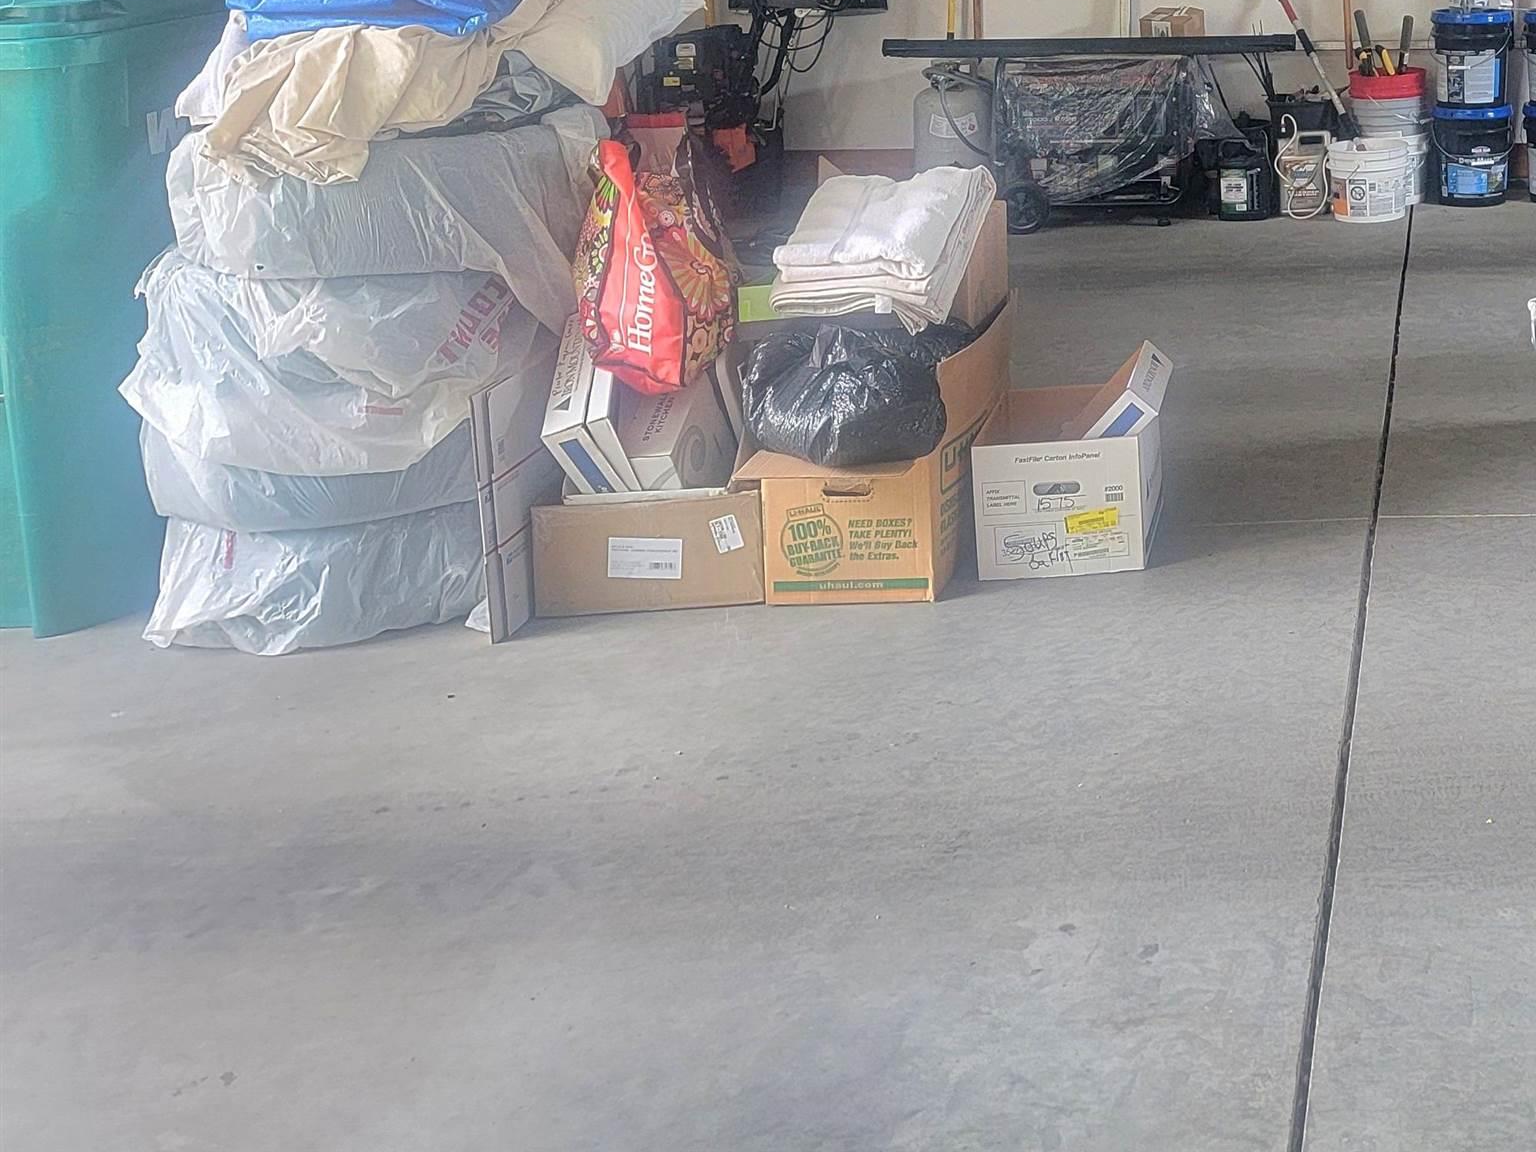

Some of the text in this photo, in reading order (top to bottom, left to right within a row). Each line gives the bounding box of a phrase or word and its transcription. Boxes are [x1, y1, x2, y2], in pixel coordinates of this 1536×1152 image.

[655, 396, 676, 434] KITCHEN
[1044, 453, 1067, 462] Carton
[1068, 452, 1101, 461] InfoPanel
[848, 518, 913, 529] NEED BOXES?
[787, 518, 832, 542] 100%
[848, 529, 913, 540] TAKE PLENTY!
[849, 539, 918, 552] We'll Buy Back
[849, 551, 900, 561] the Extras.
[819, 580, 885, 590] uhaul.com
